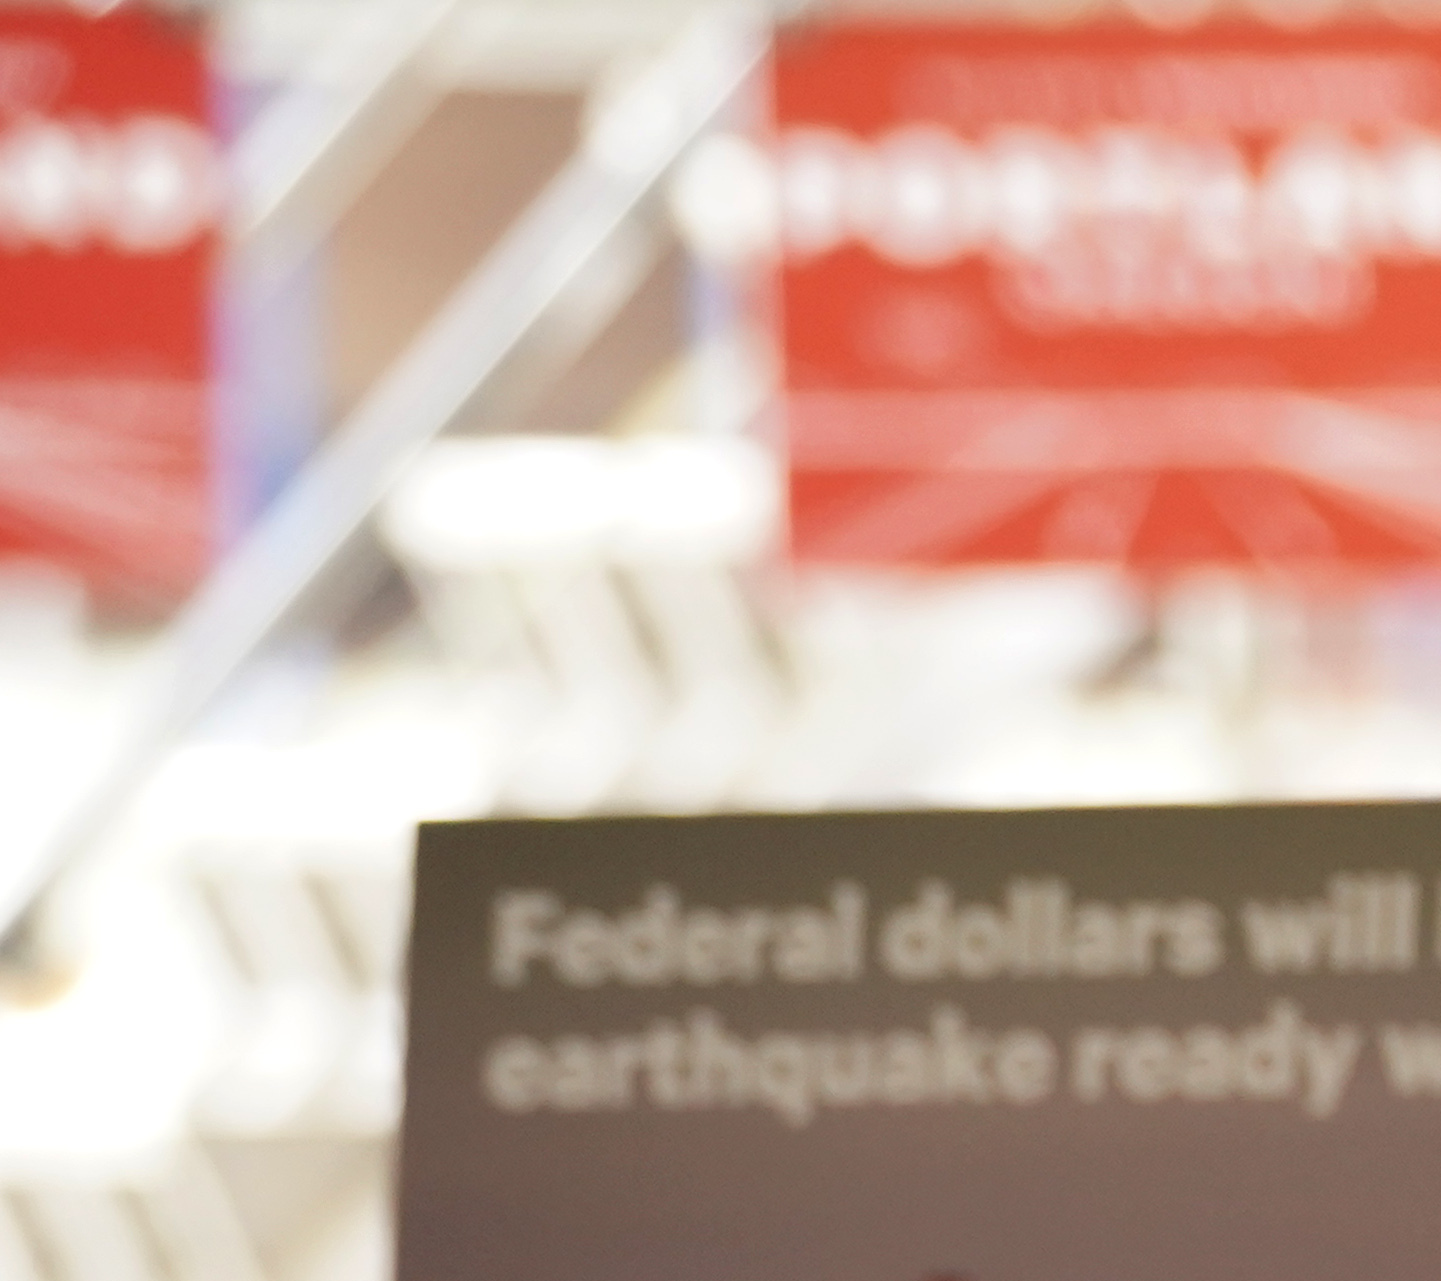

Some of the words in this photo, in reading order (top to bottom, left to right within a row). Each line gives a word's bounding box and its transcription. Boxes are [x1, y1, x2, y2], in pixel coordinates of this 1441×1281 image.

[494, 882, 866, 985] Federal
[882, 877, 1222, 979] dollars
[1243, 871, 1418, 973] will
[486, 1005, 1054, 1128] earthquake
[1073, 1000, 1362, 1119] ready
